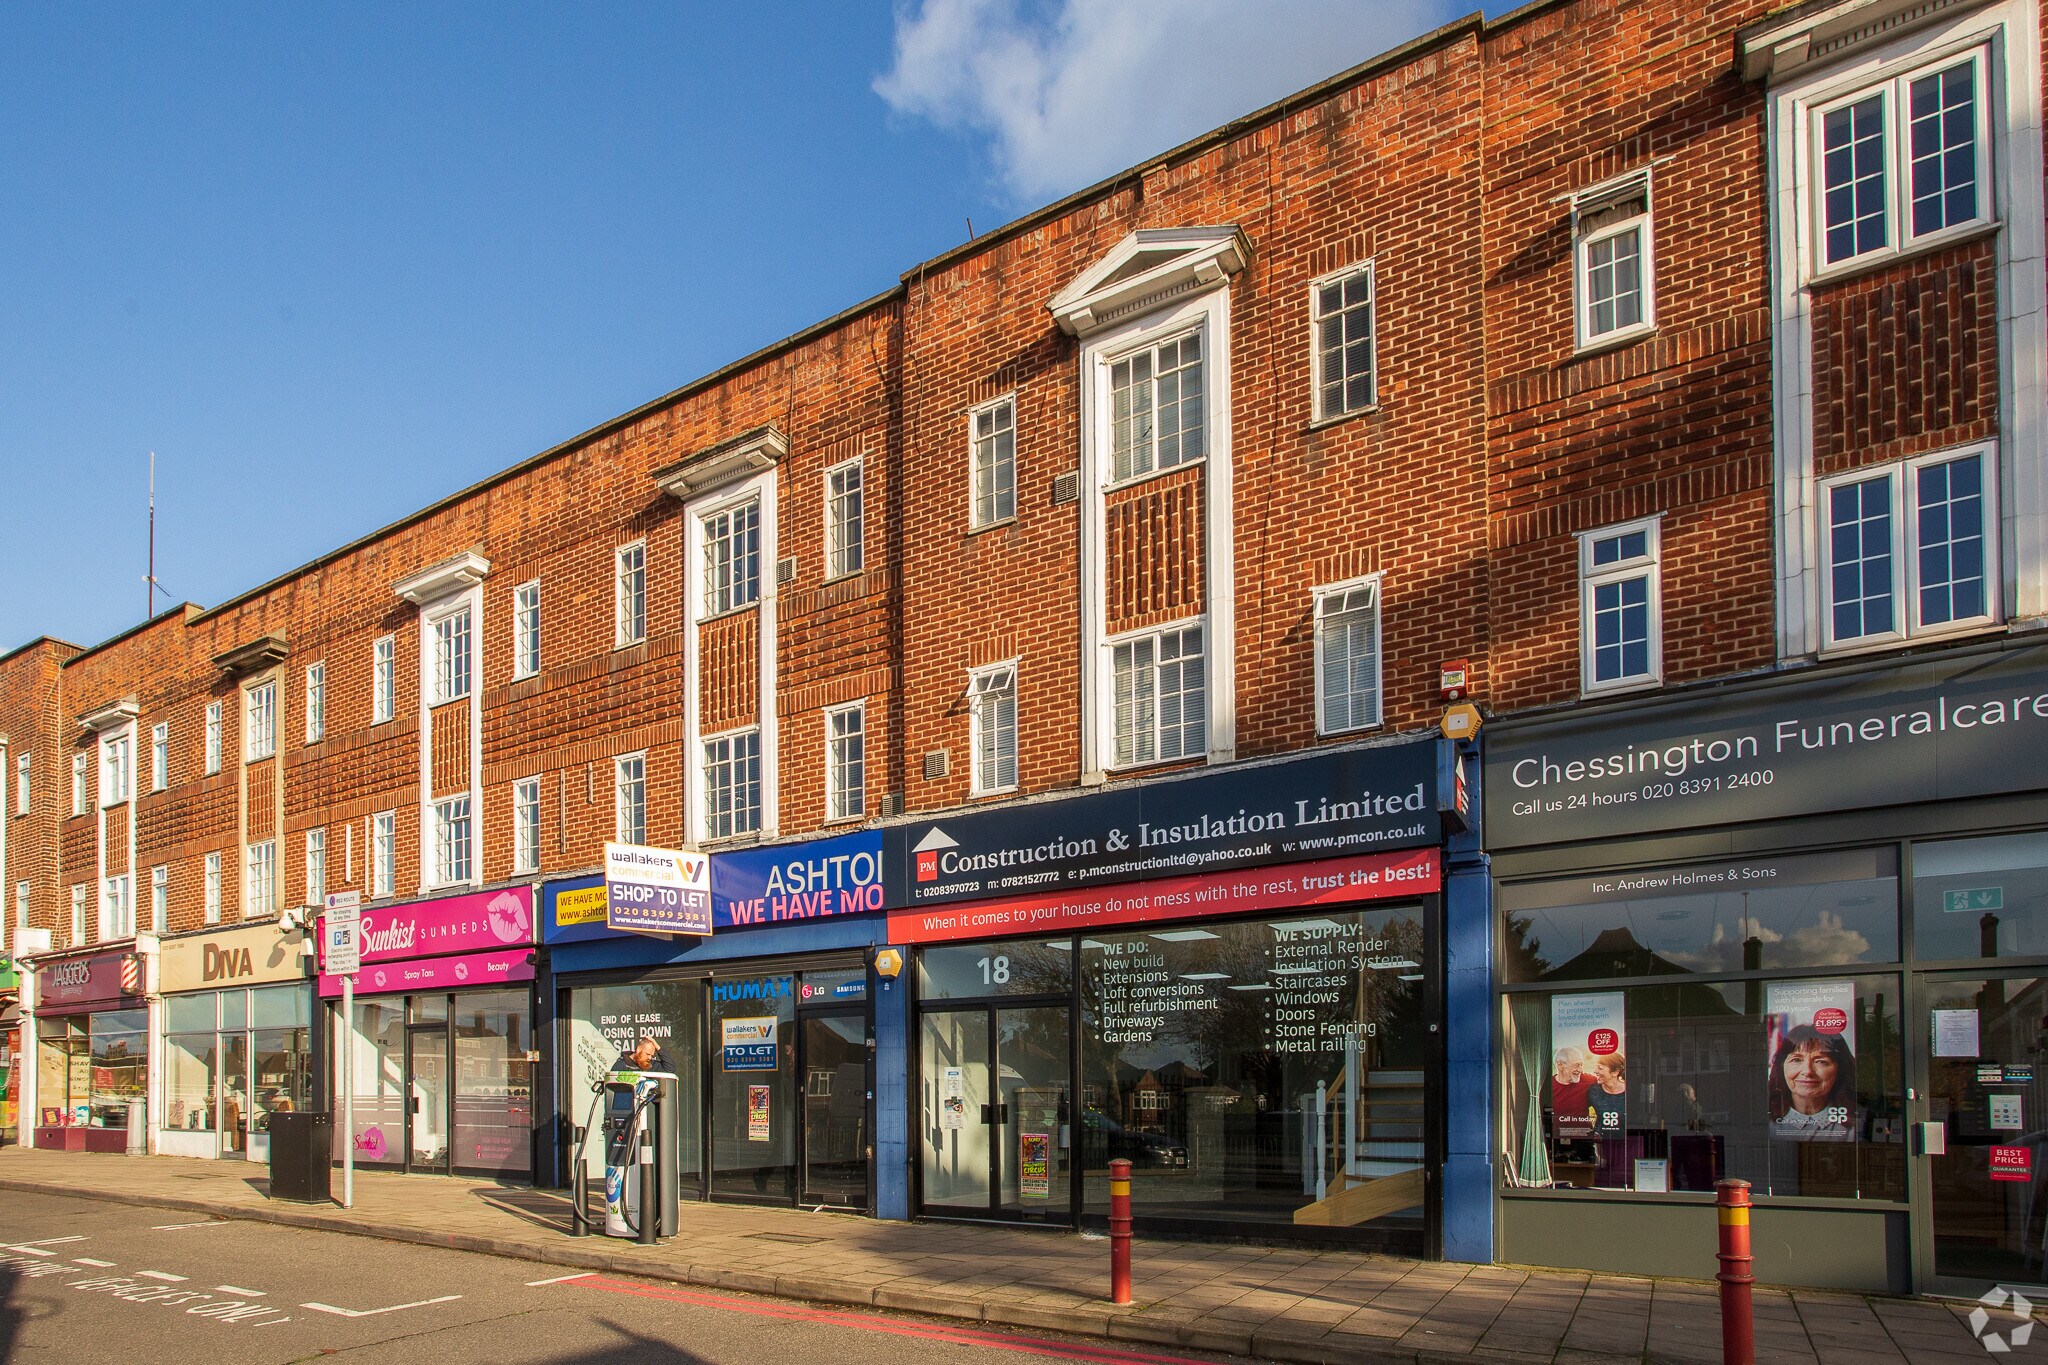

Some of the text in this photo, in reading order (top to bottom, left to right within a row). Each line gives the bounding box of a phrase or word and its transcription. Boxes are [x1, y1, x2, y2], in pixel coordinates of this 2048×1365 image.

[1512, 693, 2048, 789] Chessington Funeralcare
[1513, 770, 1774, 816] Call us 24 hours 020 8391 2400
[940, 836, 1097, 874] Construction
[1106, 829, 1129, 851] &
[1138, 809, 1285, 848] Insulation
[1295, 783, 1426, 826] Limited
[612, 852, 673, 868] wallakers
[915, 823, 1425, 898] t: 02083970723 m: 07821527772 e: p.mconstructionltd@yahoo.co.uk w: www.pmcon.co.uk
[919, 861, 936, 872] PM
[612, 865, 674, 881] commercial
[765, 850, 883, 898] ASHTO
[1593, 867, 1776, 893] Inc. Andrew Holmes & Sons
[560, 896, 572, 907] WE
[573, 893, 593, 905] HAVE
[613, 884, 705, 908] SHOP TO LET
[923, 862, 1431, 930] When it comes to your house do not mess with the rest, trust the best!
[730, 884, 883, 925] WE HAVE MO
[614, 906, 706, 922] 020 8399 5381
[615, 917, 706, 929] www.wallakerscommercial.com
[360, 917, 488, 957] Sunkist SUNBEDS
[1275, 923, 1363, 942] WE SUPPLY:
[1103, 941, 1149, 956] WE DO:
[1275, 938, 1390, 958] External Render
[487, 962, 510, 972] Beauty
[977, 955, 1010, 985] 18
[1103, 955, 1164, 970] New build
[1275, 954, 1404, 973] Insulation System
[404, 968, 434, 980] Spray Tans
[1103, 970, 1169, 985] Extensions
[713, 976, 793, 1000] HUMAX
[814, 984, 865, 995] LG SAMSUNG
[1275, 975, 1347, 990] Staircases
[1103, 983, 1204, 999] Loft conversions
[1275, 991, 1339, 1005] Windows
[1774, 985, 1848, 996] Supporting families
[1103, 998, 1218, 1013] Full refurbishment
[601, 1013, 660, 1024] END OF LEASE
[1103, 1014, 1164, 1029] Driveways
[1275, 1008, 1315, 1021] Doors
[640, 1026, 671, 1038] DOWN
[726, 1025, 757, 1033] wallakers
[1103, 1030, 1152, 1043] Gardens
[1275, 1021, 1376, 1037] Stone Fencing
[613, 1039, 642, 1052] SAL
[727, 1046, 773, 1056] TO LET
[1275, 1038, 1366, 1053] Metal railing
[1995, 1156, 2024, 1164] PRICE
[1996, 1149, 2022, 1157] BEST
